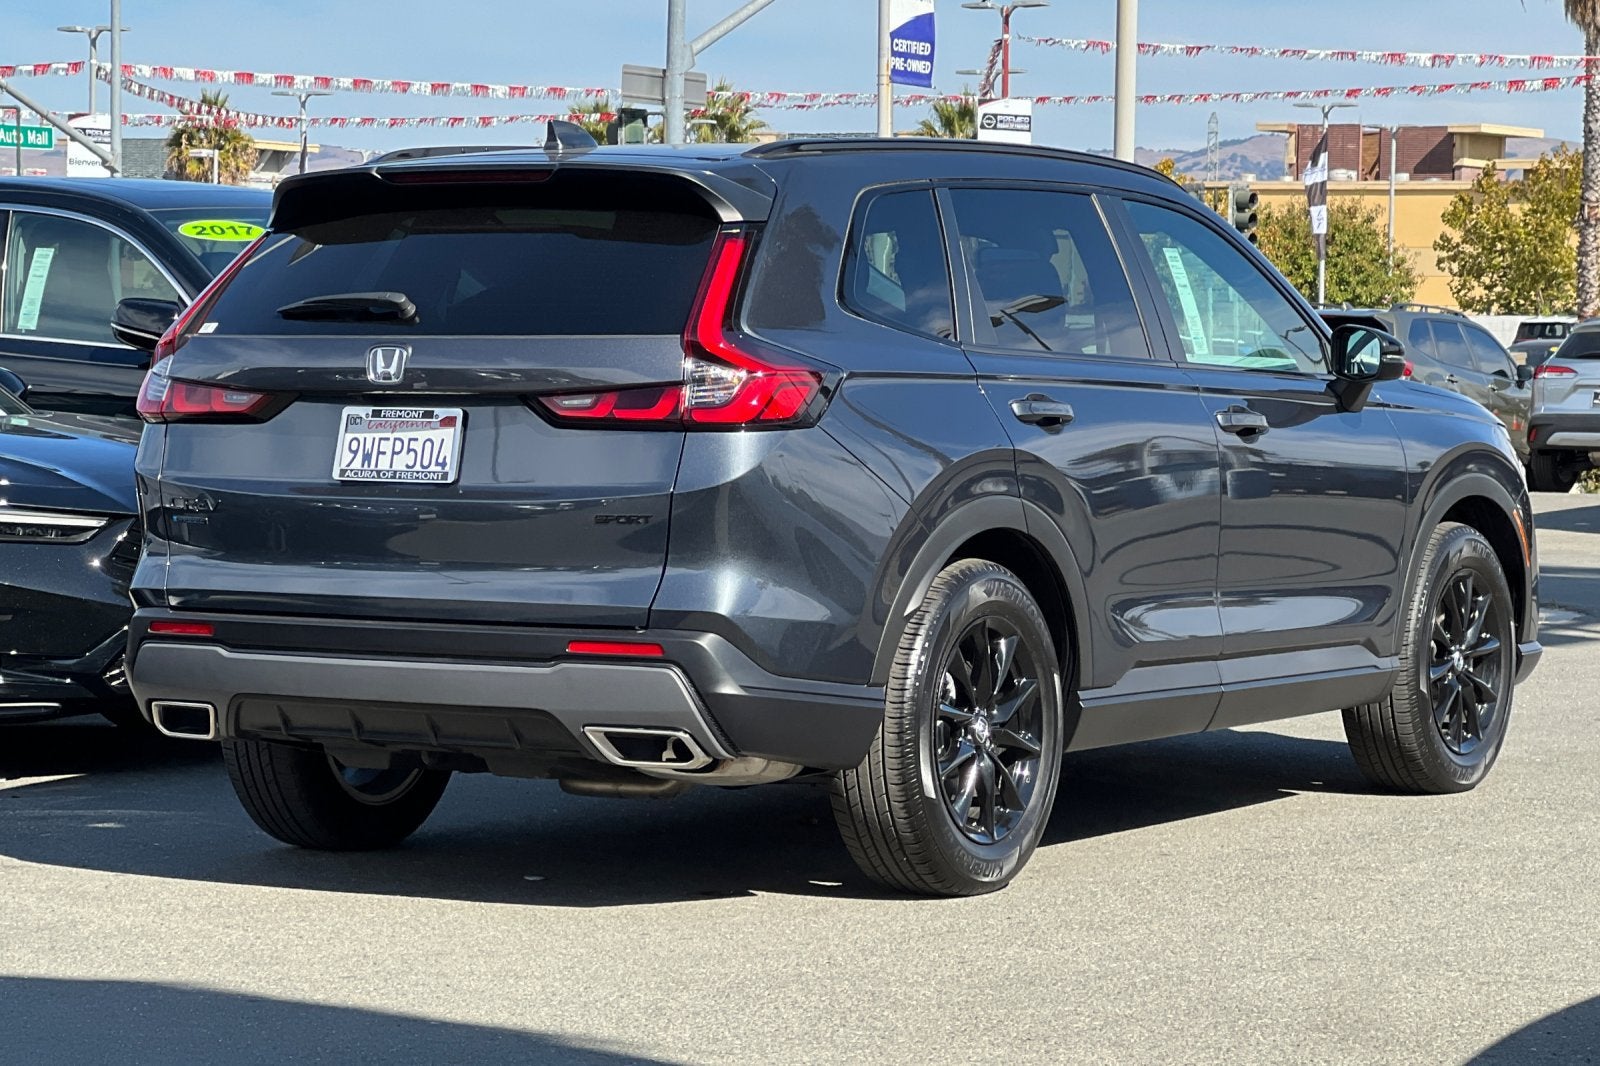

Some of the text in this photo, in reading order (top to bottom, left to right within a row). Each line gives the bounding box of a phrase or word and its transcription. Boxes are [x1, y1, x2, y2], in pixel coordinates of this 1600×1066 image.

[893, 38, 931, 56] CERTIFIED
[891, 56, 931, 74] PRE-OWNED
[27, 129, 49, 146] Mall
[69, 158, 102, 167] Bienven
[191, 224, 253, 237] 2017
[380, 410, 425, 419] FREMONT
[367, 420, 432, 434] California
[345, 436, 448, 471] 9WFP504
[344, 469, 443, 480] ACURA OF FREMONT
[594, 514, 654, 525] SPORT
